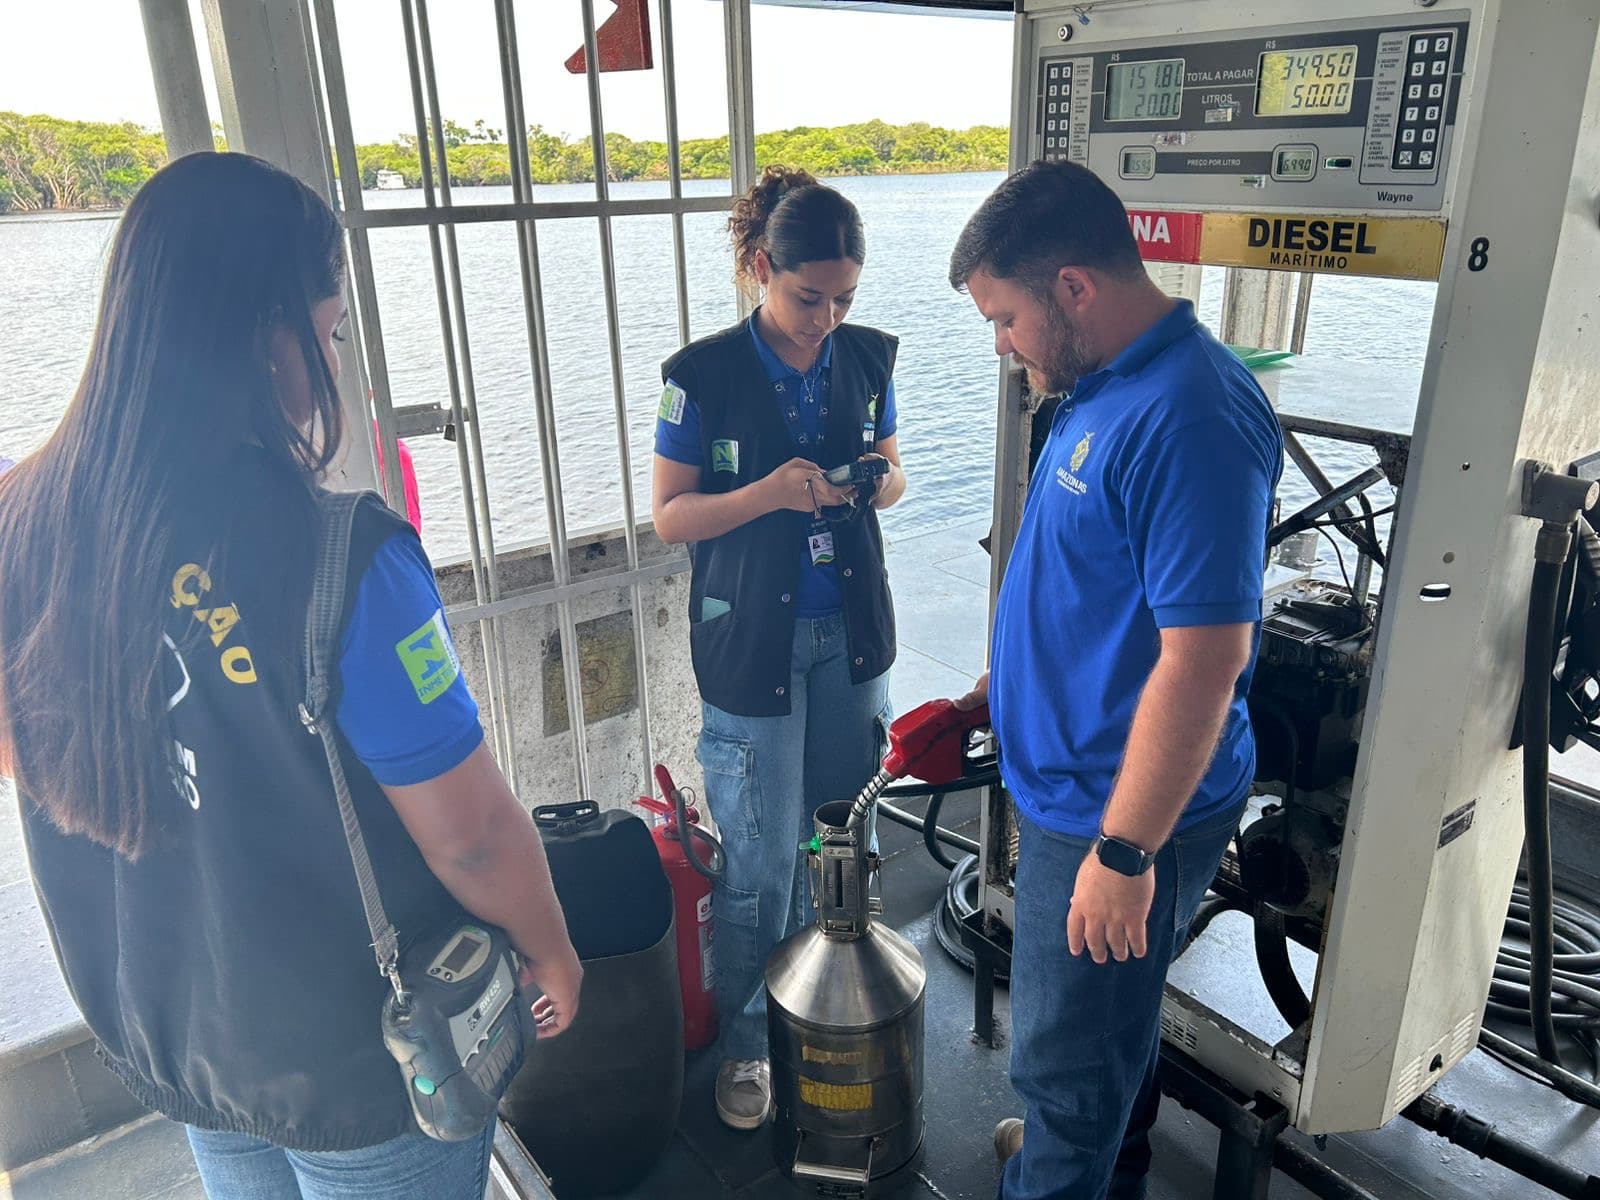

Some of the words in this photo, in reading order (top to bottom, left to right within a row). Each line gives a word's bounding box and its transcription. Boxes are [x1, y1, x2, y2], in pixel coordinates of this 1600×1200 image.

[1265, 41, 1276, 49] R$
[1111, 53, 1120, 62] R$
[1186, 72, 1213, 82] TOTAL
[1214, 71, 1222, 80] A
[1222, 69, 1254, 79] PAGAR
[1201, 94, 1232, 104] LITROS
[1290, 83, 1350, 108] 50.00
[1187, 159, 1208, 167] PREÇO
[1208, 158, 1221, 166] POR
[1222, 158, 1241, 166] LITRO
[1377, 191, 1413, 203] Wayne
[1127, 215, 1170, 243] NA
[1247, 217, 1377, 255] DIESEL
[1269, 250, 1348, 269] MARÍTIMO
[1467, 237, 1490, 272] 8
[1056, 466, 1087, 494] AMAZONAS
